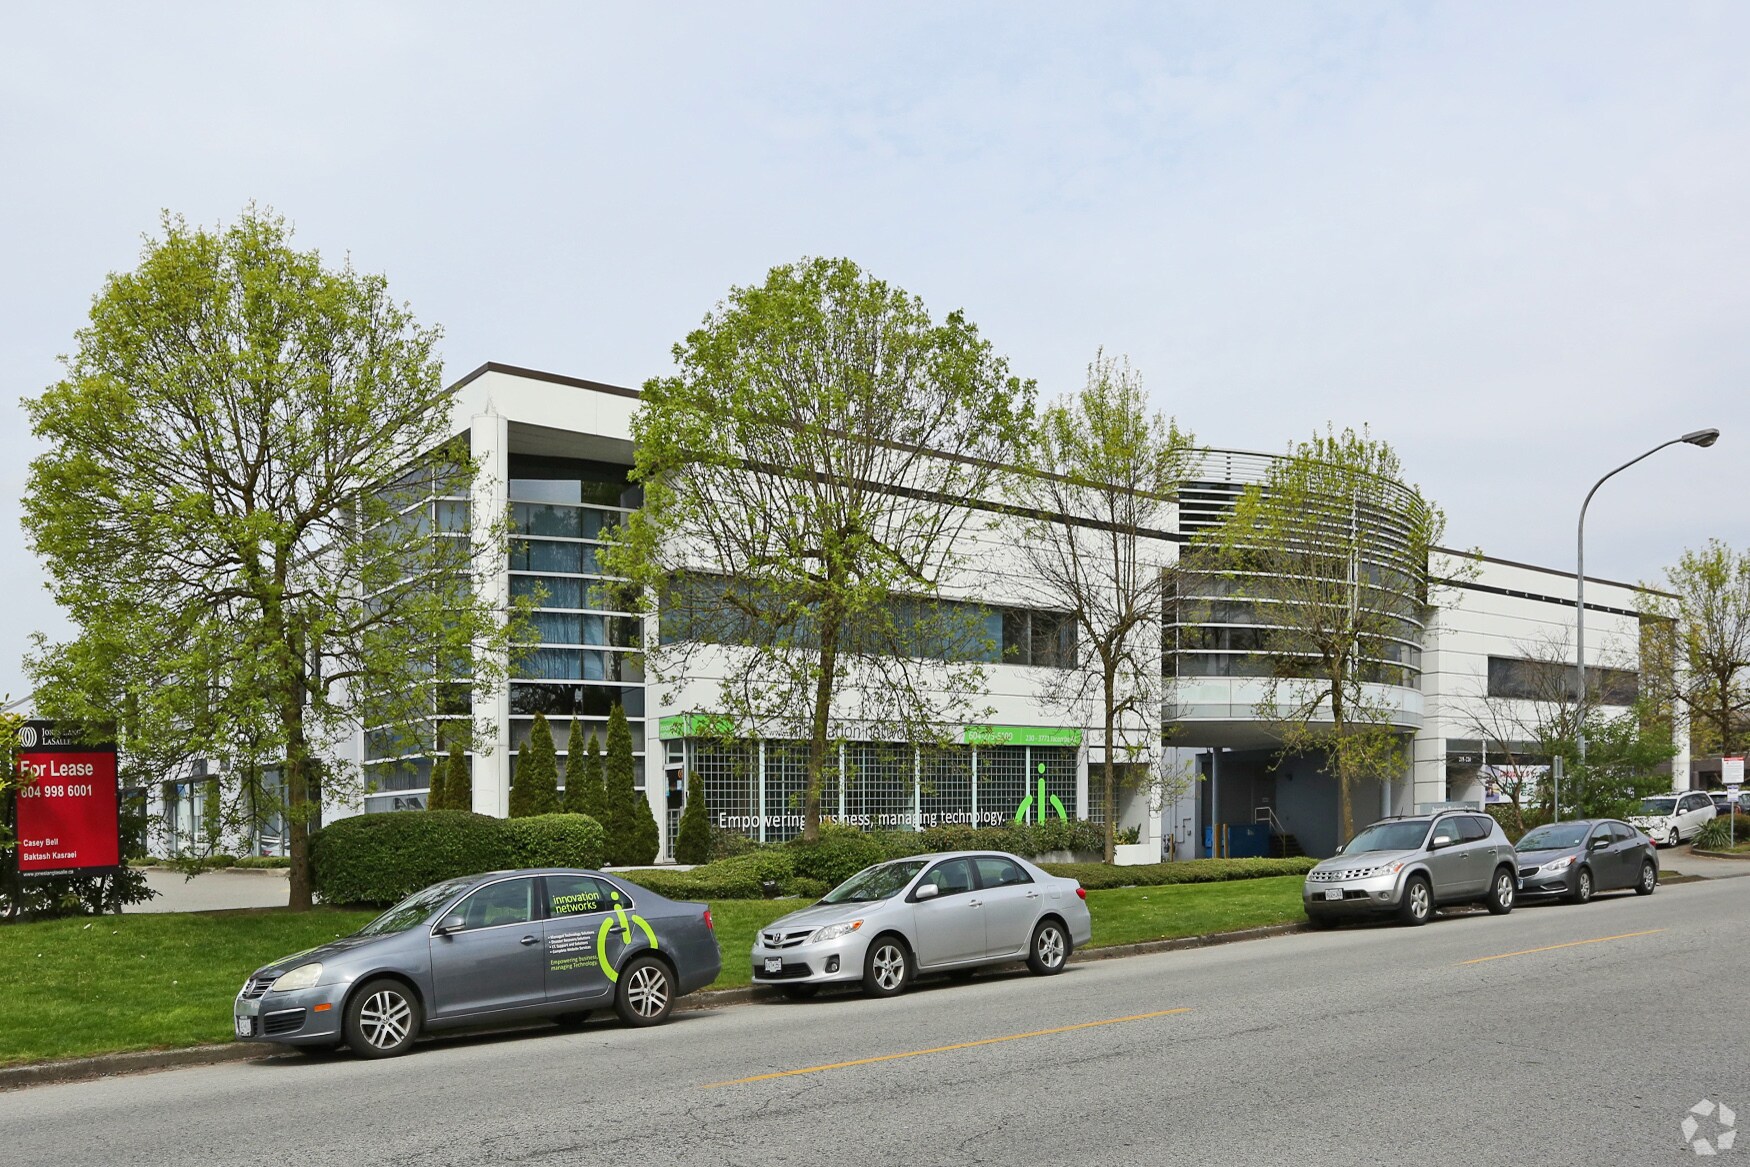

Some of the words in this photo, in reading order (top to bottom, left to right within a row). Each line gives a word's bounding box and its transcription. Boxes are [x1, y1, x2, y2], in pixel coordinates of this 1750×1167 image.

[21, 760, 46, 777] For
[50, 760, 93, 777] Lease
[21, 786, 41, 798] 604
[44, 785, 64, 798] 998
[67, 784, 92, 797] 6001
[878, 809, 937, 827] managing
[940, 808, 1006, 827] technology.
[23, 839, 44, 848] Casey
[45, 838, 59, 846] Bell
[23, 852, 51, 861] Baktash
[52, 850, 77, 859] Kasraei
[553, 891, 600, 905] innovation
[555, 901, 597, 914] networks
